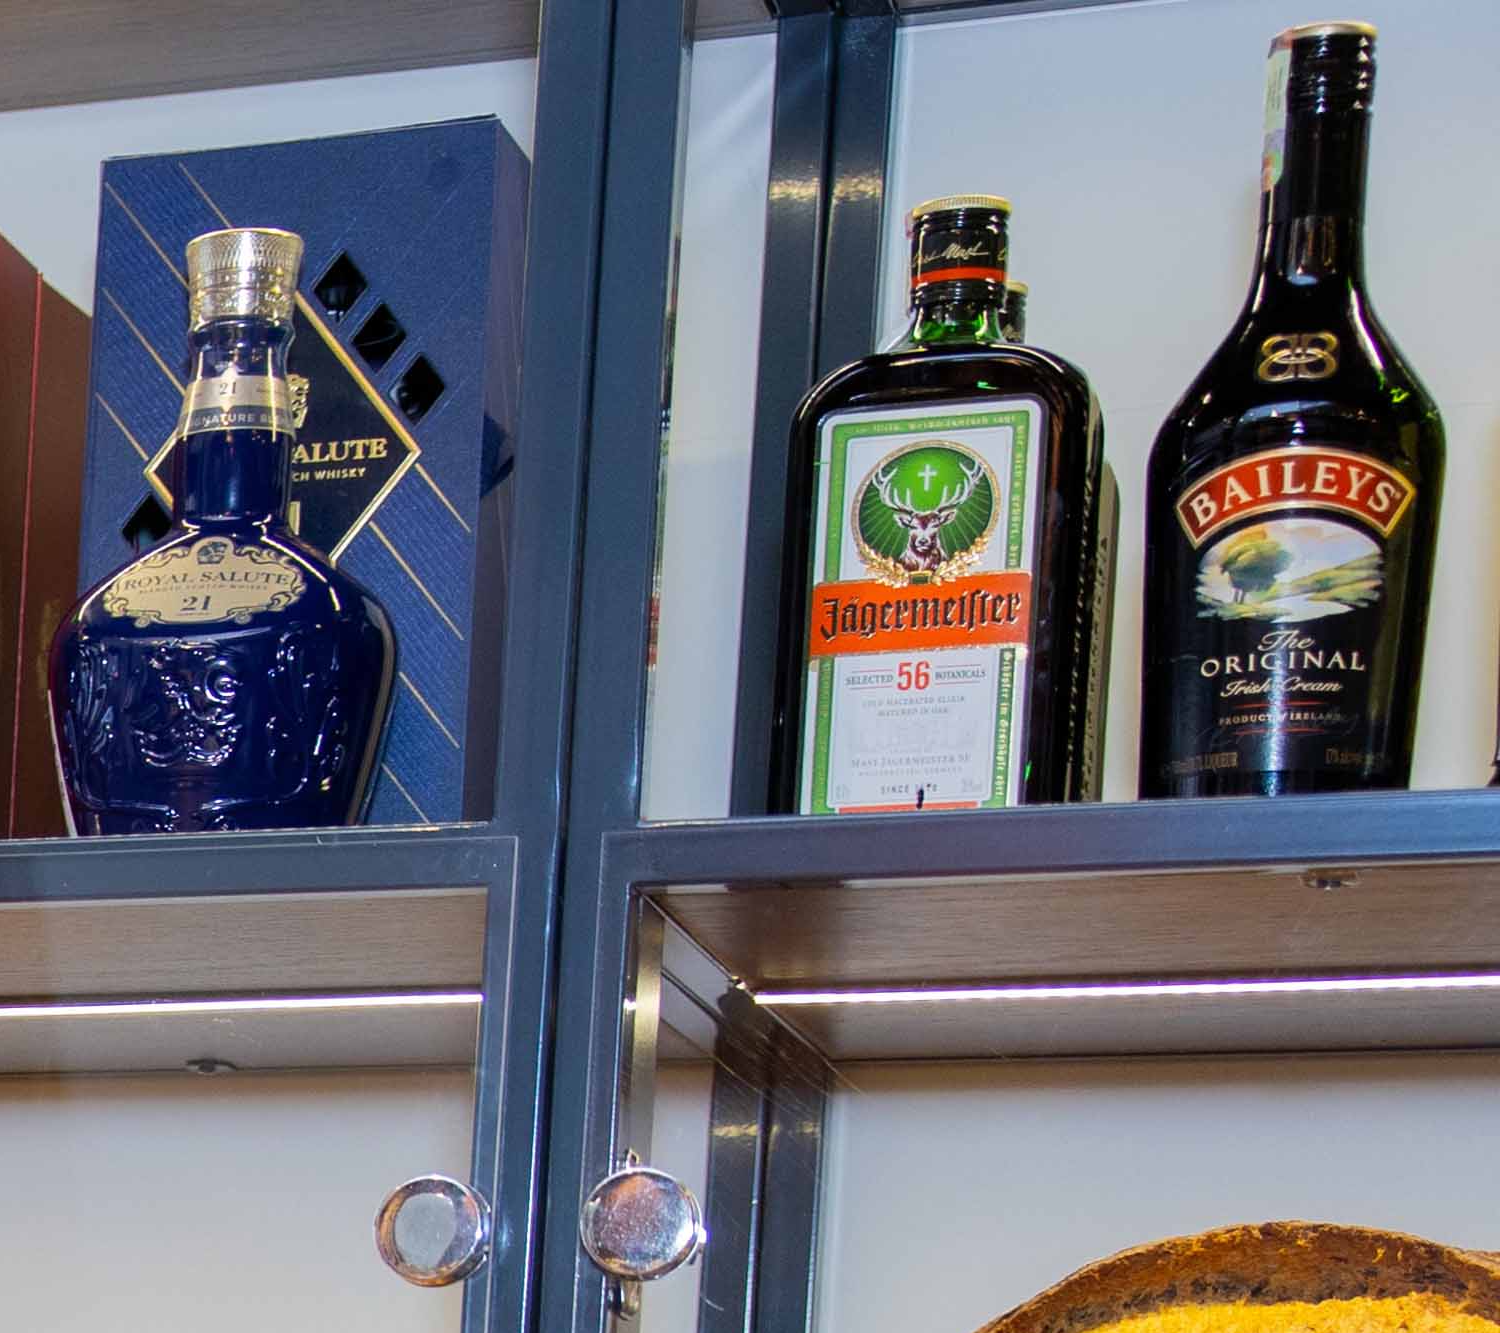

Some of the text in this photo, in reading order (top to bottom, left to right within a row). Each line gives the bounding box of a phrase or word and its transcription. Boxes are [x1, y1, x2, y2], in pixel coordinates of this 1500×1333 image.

[292, 438, 388, 464] ALUTE
[314, 467, 366, 481] WHISKY
[1189, 461, 1396, 527] BAILEYS
[124, 570, 291, 592] ROYAL SALUTE
[180, 595, 213, 612] 21
[820, 589, 1023, 642] Jägermeister
[1258, 630, 1315, 651] The
[845, 661, 987, 691] SELECTED 56 BOTANICALS
[1201, 651, 1366, 678] ORIGINAL
[1220, 677, 1342, 698] Irish Cream
